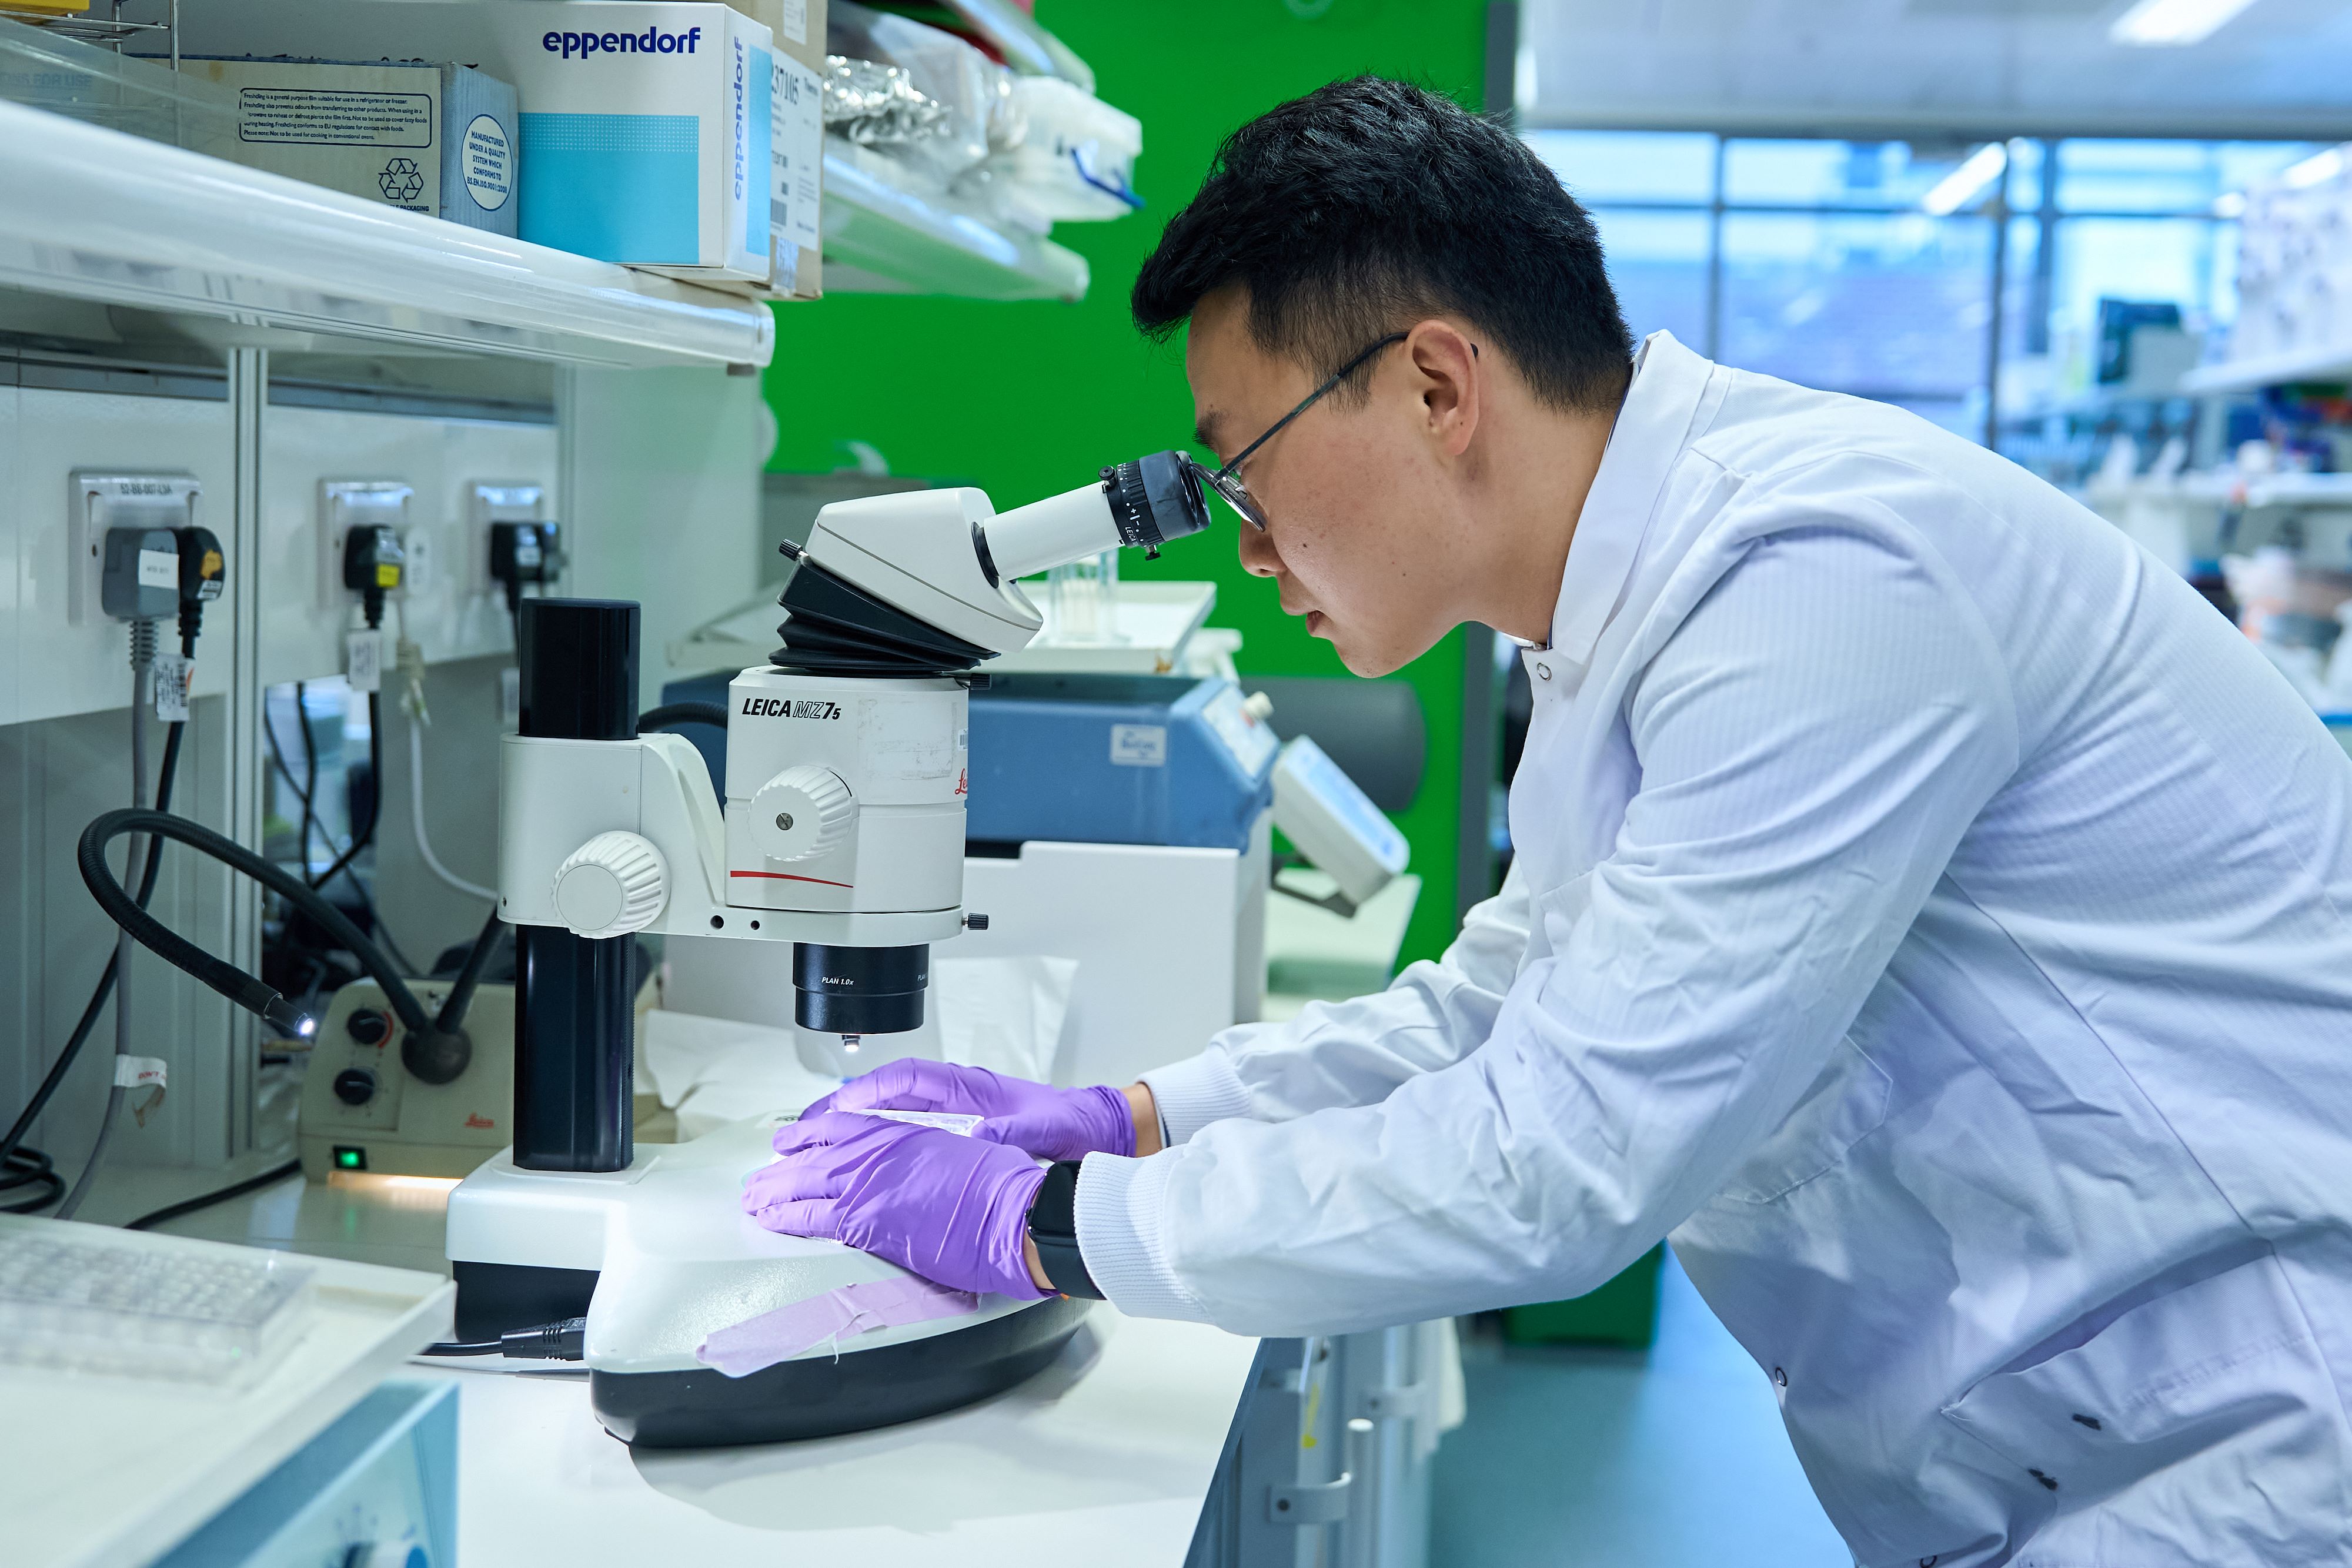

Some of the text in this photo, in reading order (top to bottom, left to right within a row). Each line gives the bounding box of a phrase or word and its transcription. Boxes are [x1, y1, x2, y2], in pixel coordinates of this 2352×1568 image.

[543, 26, 700, 59] eppendorf
[734, 36, 743, 200] eppendorf
[472, 130, 504, 148] MANUFACTURED
[469, 141, 483, 152] UNDER
[489, 147, 505, 159] QUALITY
[473, 155, 502, 170] SYSTEM WHICH
[473, 166, 502, 181] CONFORMS TO
[1125, 527, 1136, 541] LEICA
[742, 698, 791, 717] LEICA
